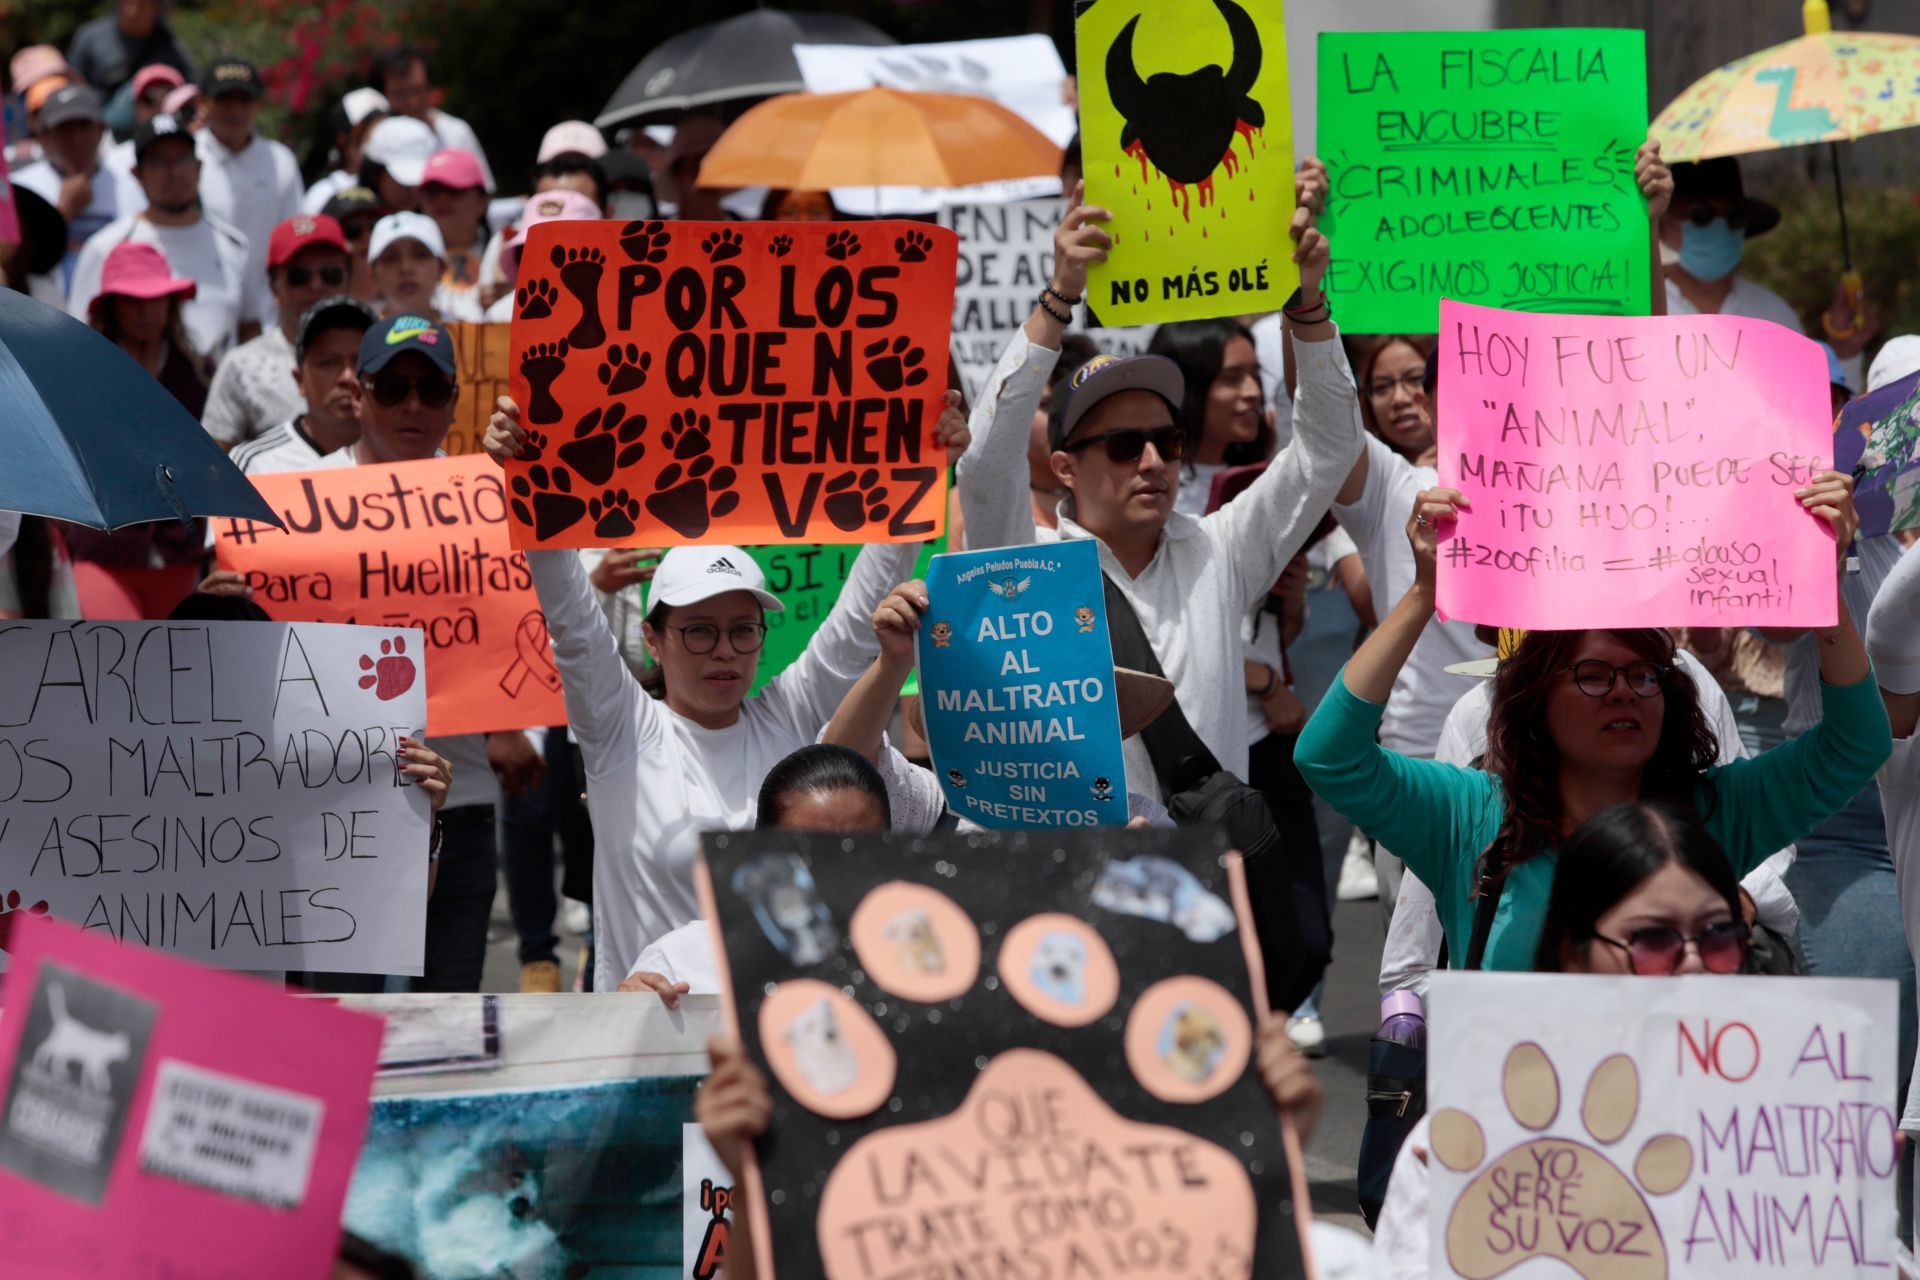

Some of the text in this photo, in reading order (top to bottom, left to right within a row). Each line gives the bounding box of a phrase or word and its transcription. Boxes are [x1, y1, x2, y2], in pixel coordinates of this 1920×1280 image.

[1343, 47, 1609, 94] LA FISCALIA
[1376, 109, 1562, 142] ENCUBRE
[1338, 154, 1615, 200] CRIMINALES
[617, 265, 901, 331] POR LOS
[1111, 258, 1269, 306] NO MÁS OLÉ
[665, 332, 787, 398] QUE
[1456, 322, 1743, 388] HOY FUE UN
[718, 398, 924, 465] TIENEN
[1460, 452, 1625, 494] MAÑANA
[1653, 456, 1752, 494] PUEDE
[761, 467, 938, 538] VZ
[359, 538, 533, 599] Huellitas
[1686, 559, 1780, 585] sexual
[976, 610, 1054, 643] ALTO
[273, 626, 330, 719] A
[1000, 648, 1040, 676] AL
[937, 677, 1104, 713] MALTRATO
[963, 716, 1086, 745] ANIMAL
[109, 726, 424, 798] MALTRADORE
[975, 759, 1081, 780] JUSTICIA
[965, 794, 1099, 827] PRETEXTOS
[1009, 784, 1046, 802] SIN
[30, 814, 281, 877] ASESINOS
[321, 811, 379, 861] DE
[82, 887, 357, 950] ANIMALES
[1677, 1017, 1873, 1082] NO AL
[977, 1086, 1077, 1147] QUE
[1698, 1101, 1898, 1184] MALTRATO
[1486, 1206, 1653, 1257] SU VOZ
[1683, 1185, 1891, 1267] ANIMAL
